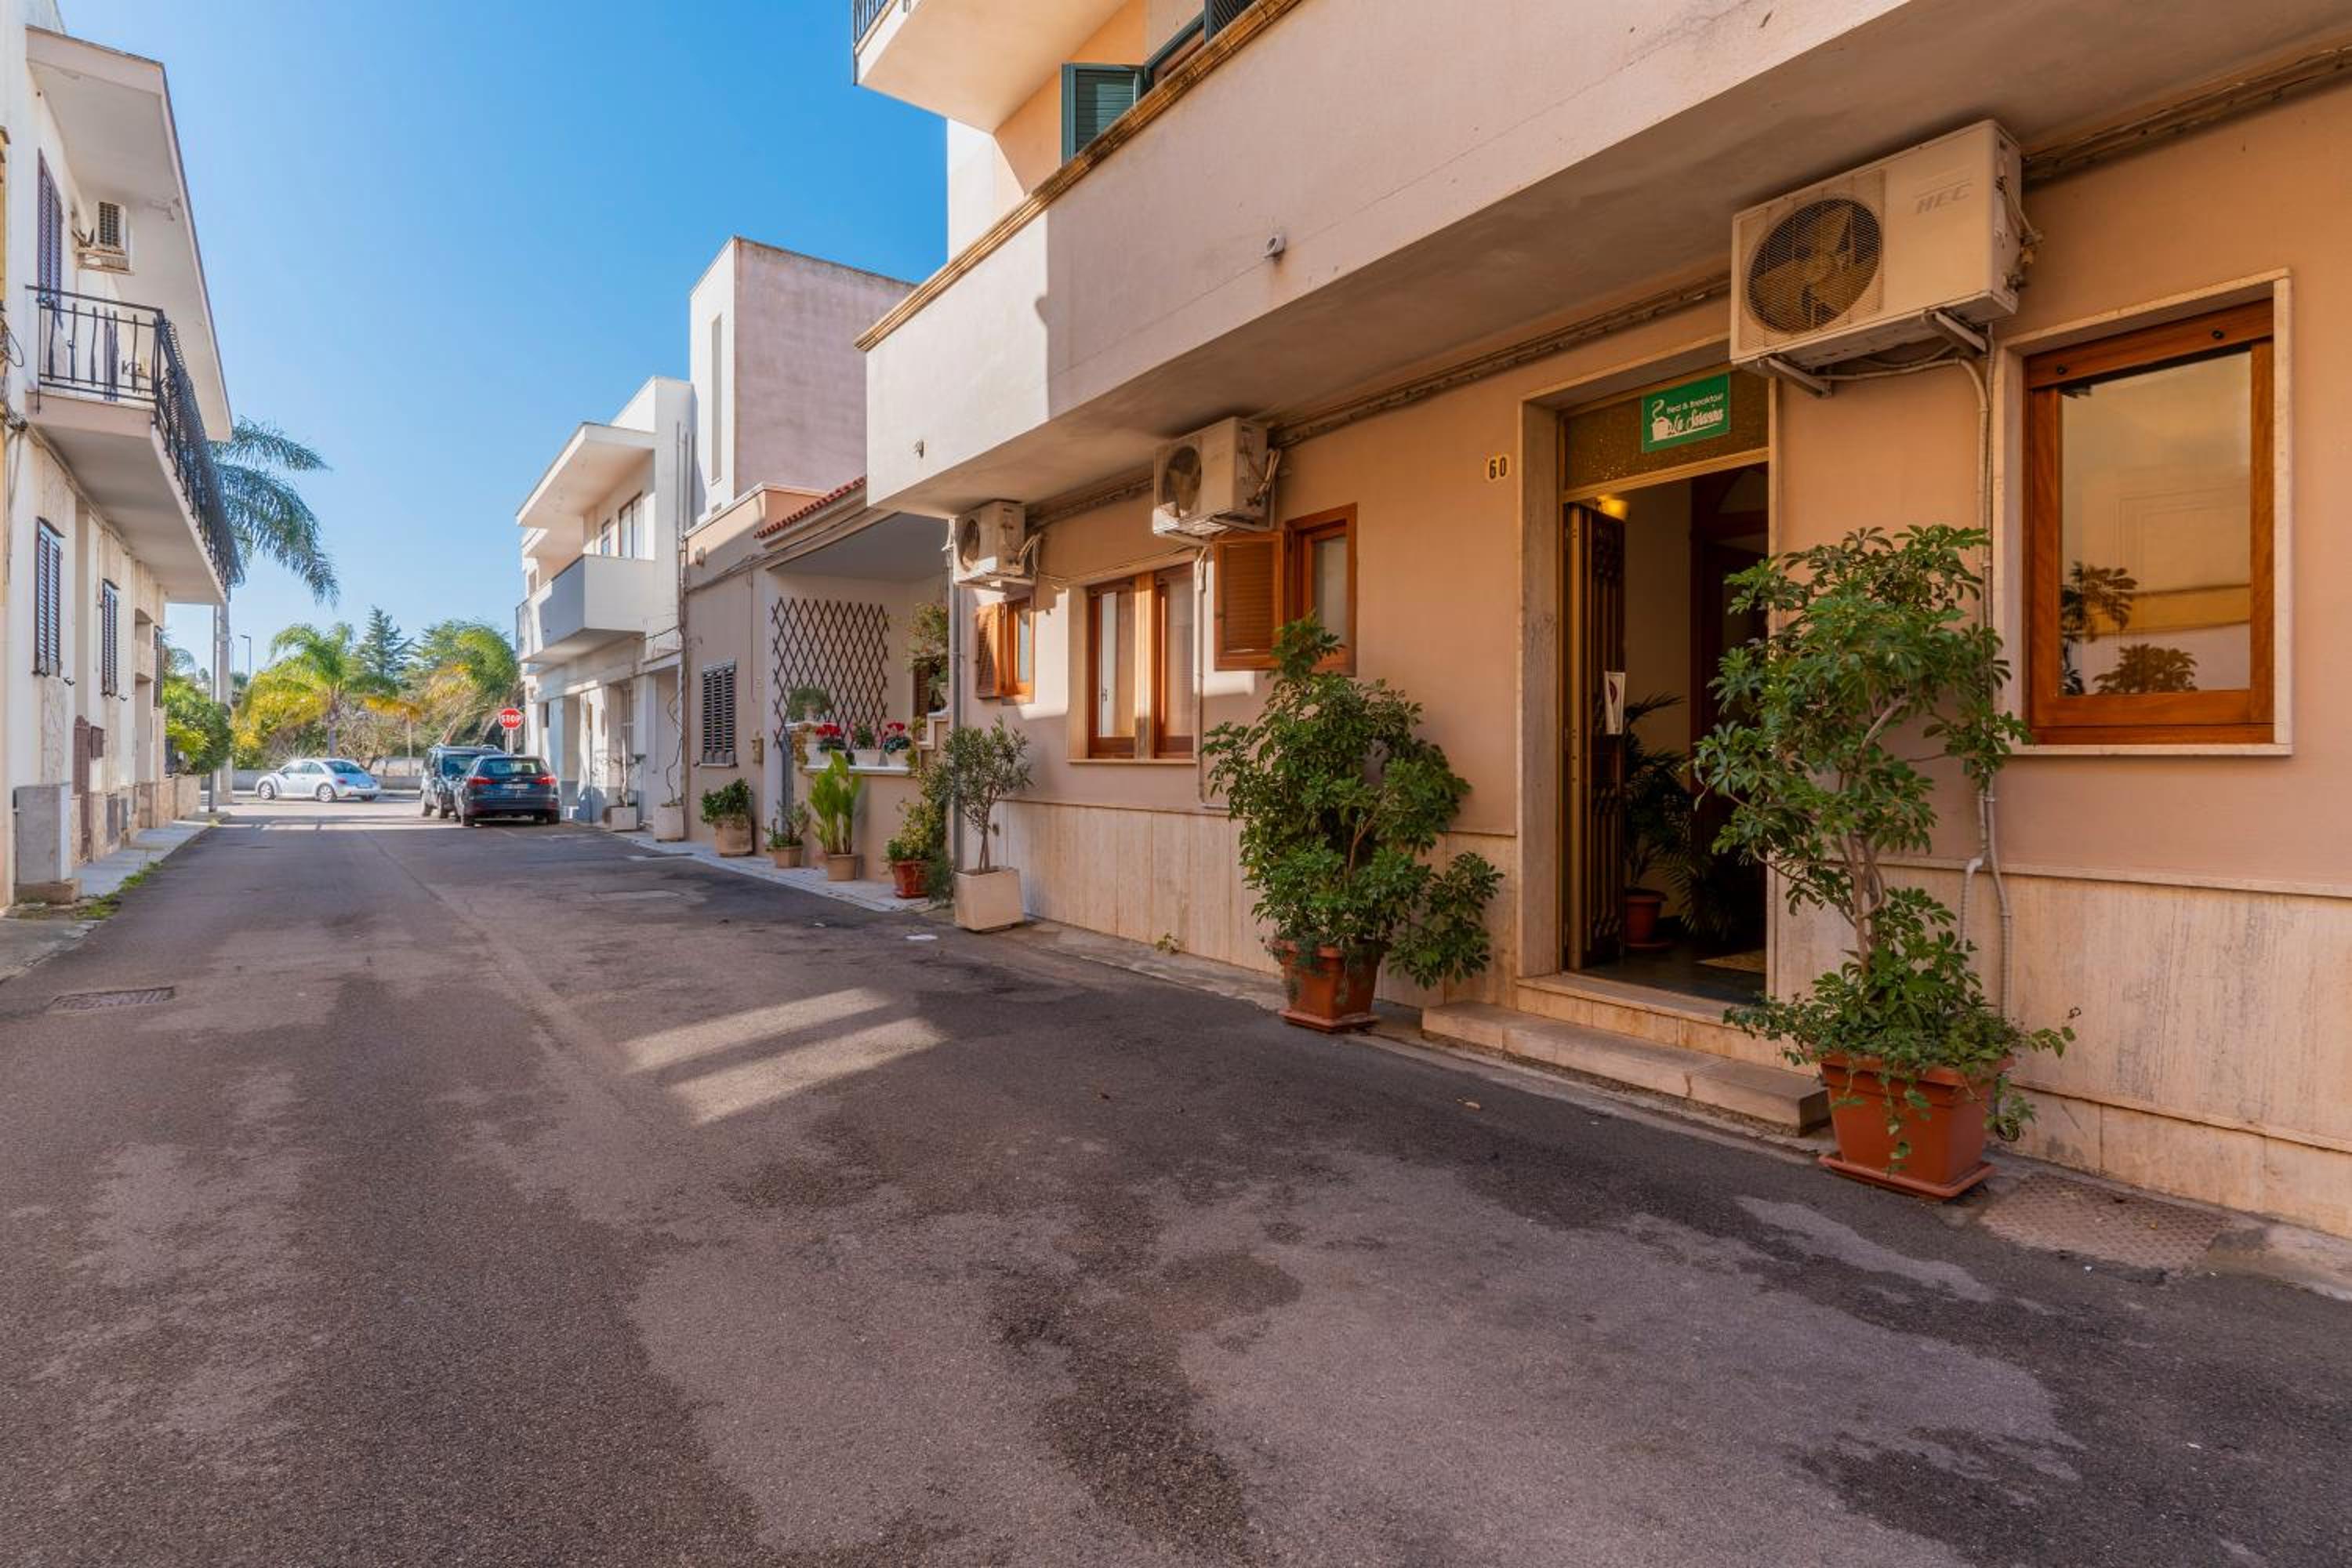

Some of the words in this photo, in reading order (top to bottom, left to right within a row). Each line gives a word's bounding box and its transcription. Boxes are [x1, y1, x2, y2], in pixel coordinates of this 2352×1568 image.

[1667, 405, 1682, 413] Bed
[1489, 456, 1507, 479] 60
[500, 714, 521, 723] STOP
